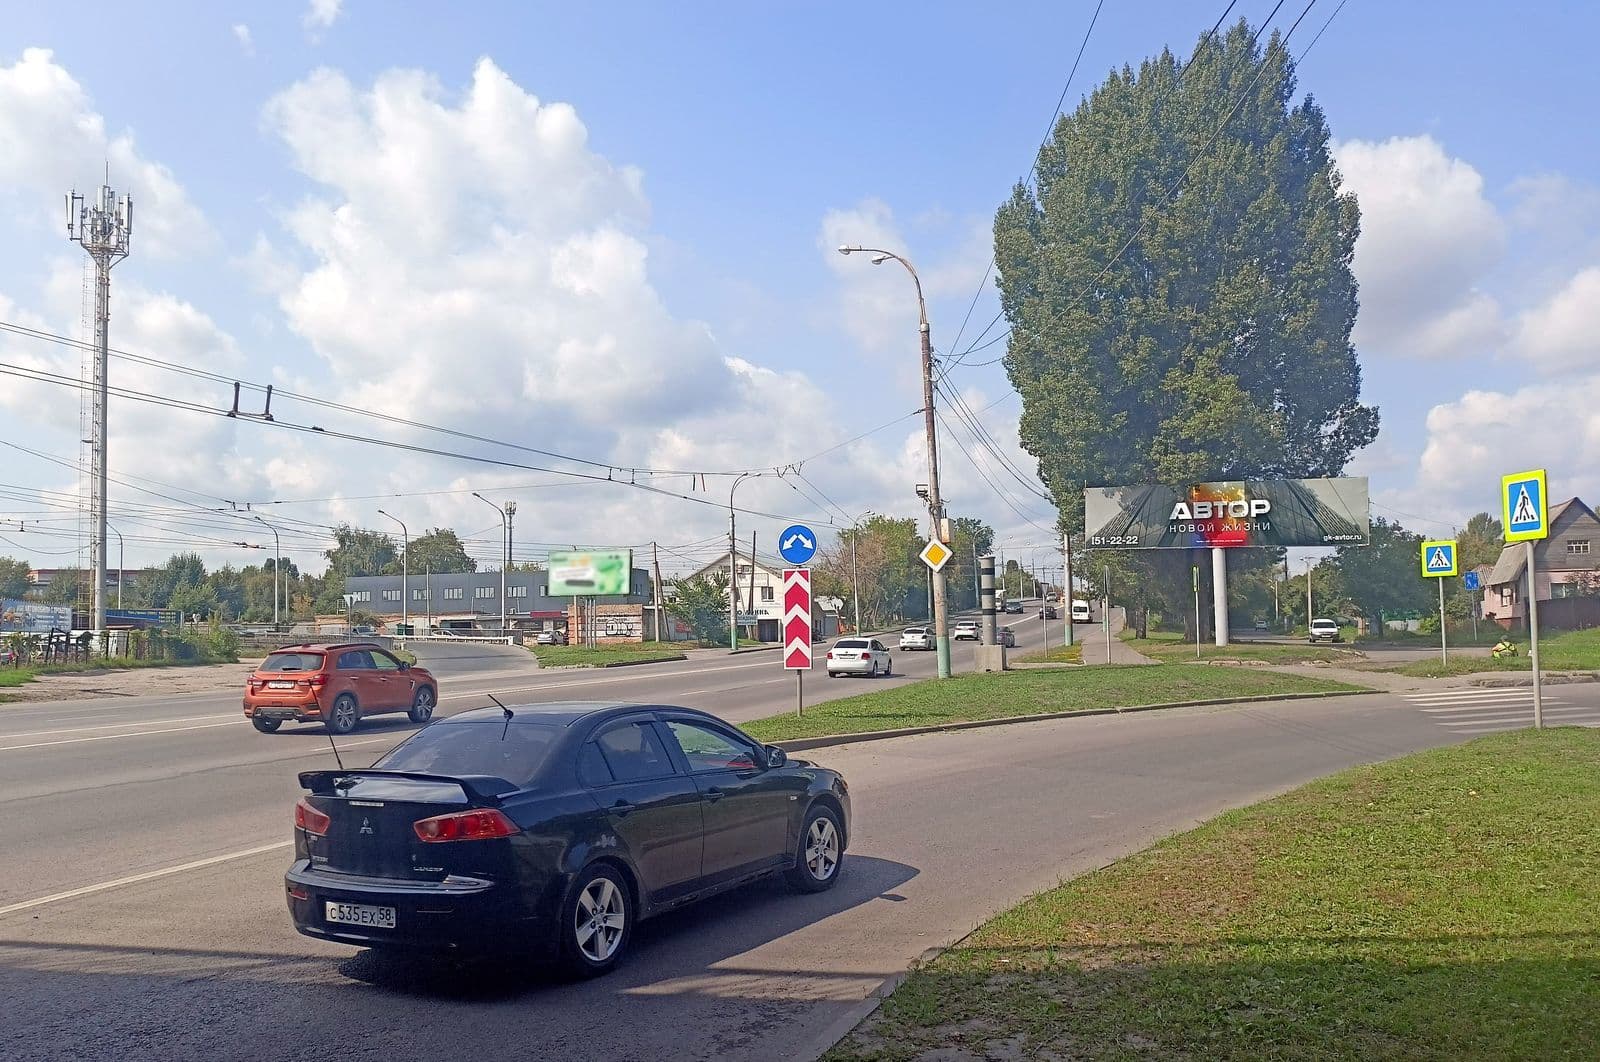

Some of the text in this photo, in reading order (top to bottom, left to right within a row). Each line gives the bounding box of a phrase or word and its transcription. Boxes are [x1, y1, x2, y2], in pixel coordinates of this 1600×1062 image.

[1169, 499, 1271, 520] АВТОР
[1169, 522, 1270, 533] НОВОЙ ЖИЗНИ
